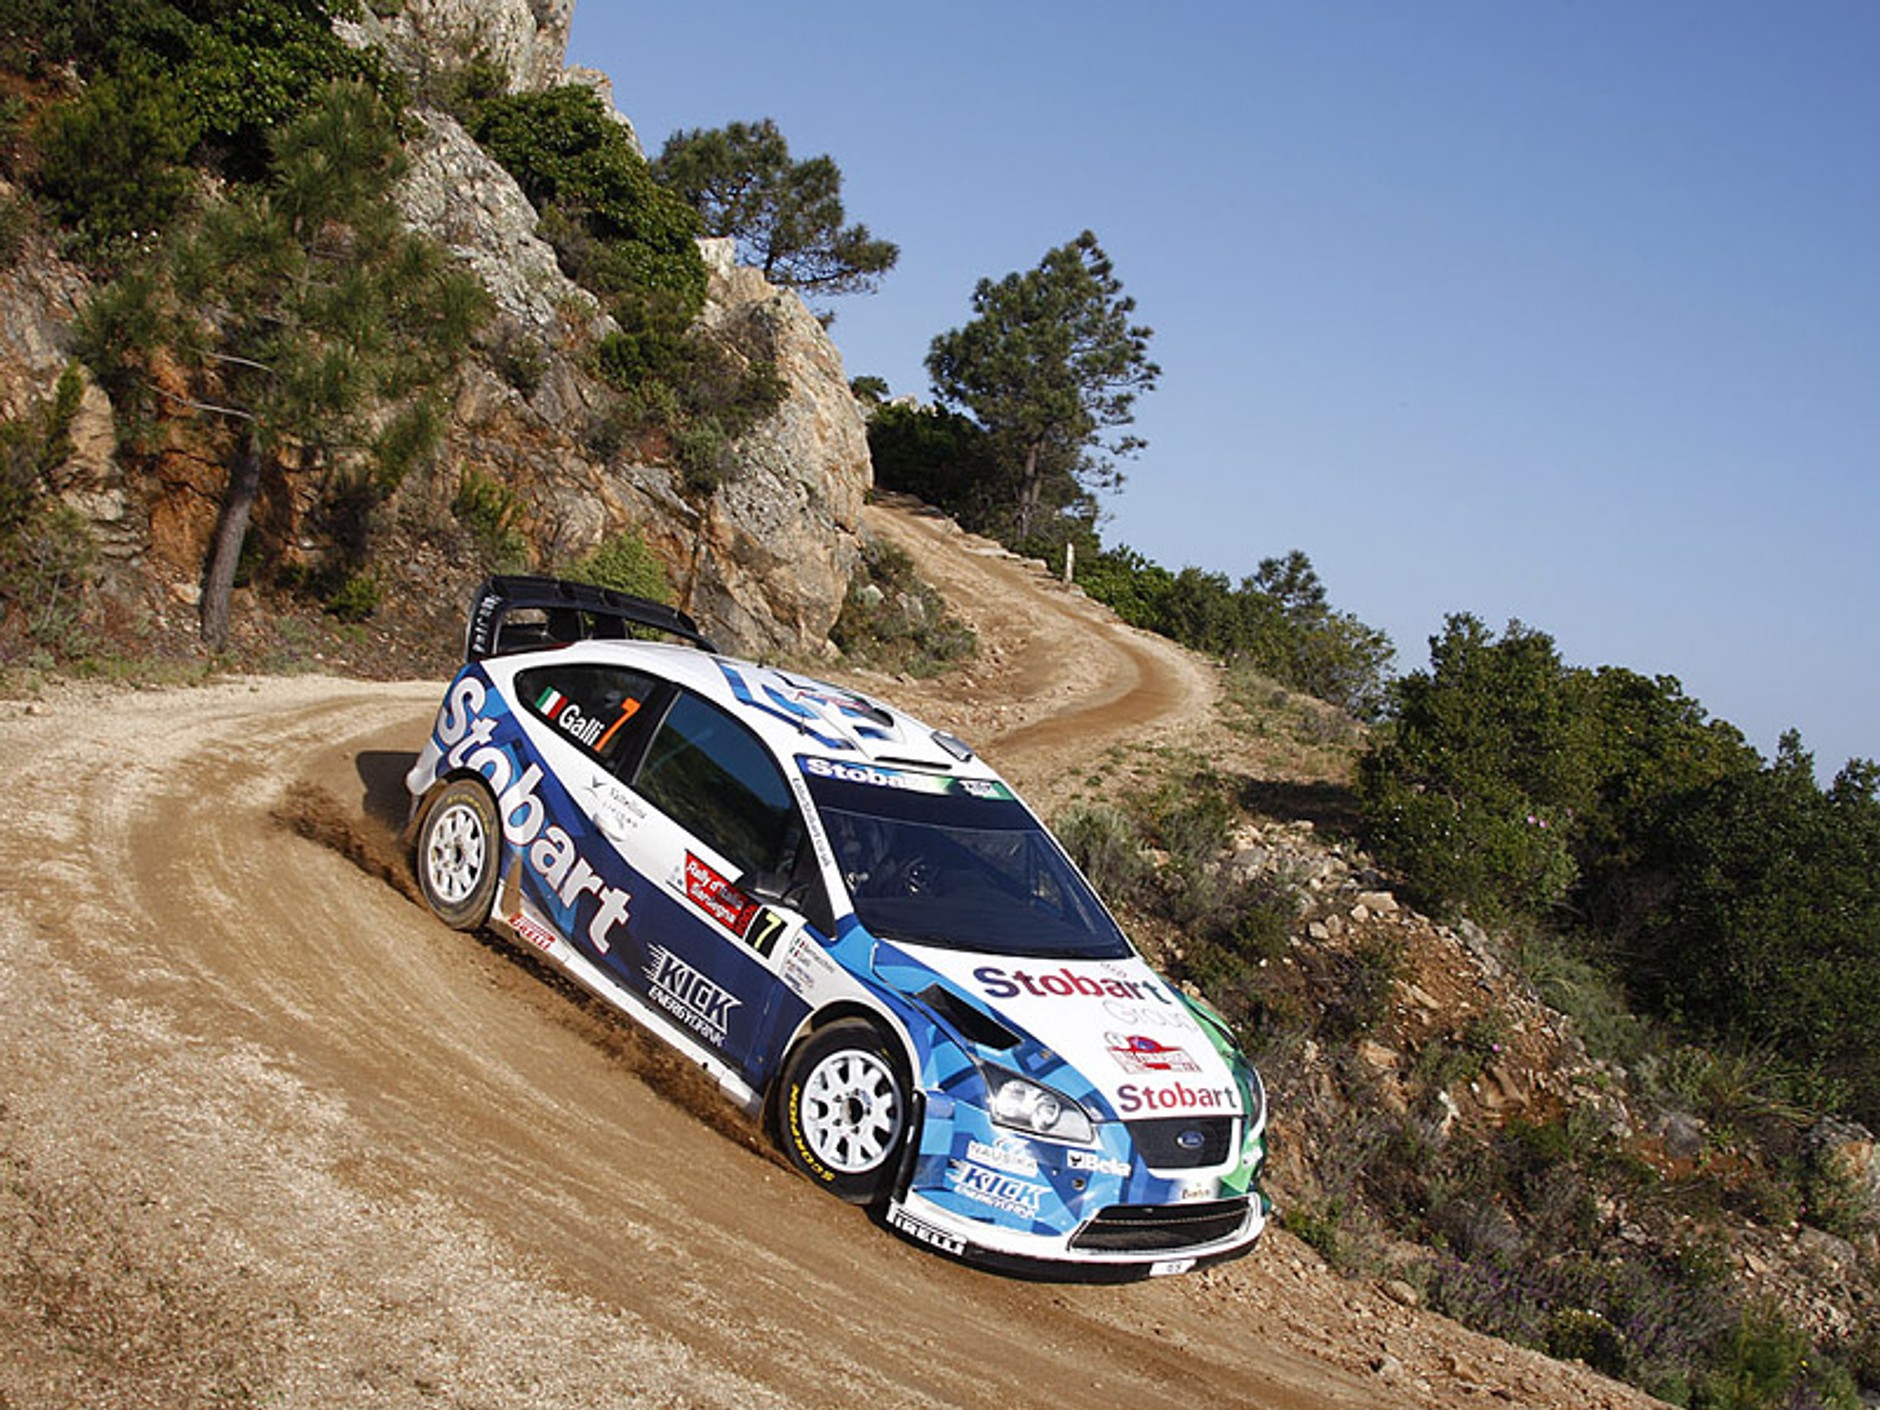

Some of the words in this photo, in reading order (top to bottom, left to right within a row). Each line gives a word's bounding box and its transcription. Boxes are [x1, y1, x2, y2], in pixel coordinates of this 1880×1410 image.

[559, 704, 606, 747] Galli
[592, 697, 641, 752] 7
[806, 757, 930, 793] Stoba
[436, 674, 632, 957] Stobart
[754, 911, 782, 950] 7
[657, 954, 733, 1033] KICK
[973, 966, 1173, 1005] Stobart
[1116, 1080, 1238, 1113] Stobart
[963, 1164, 1045, 1213] KICK
